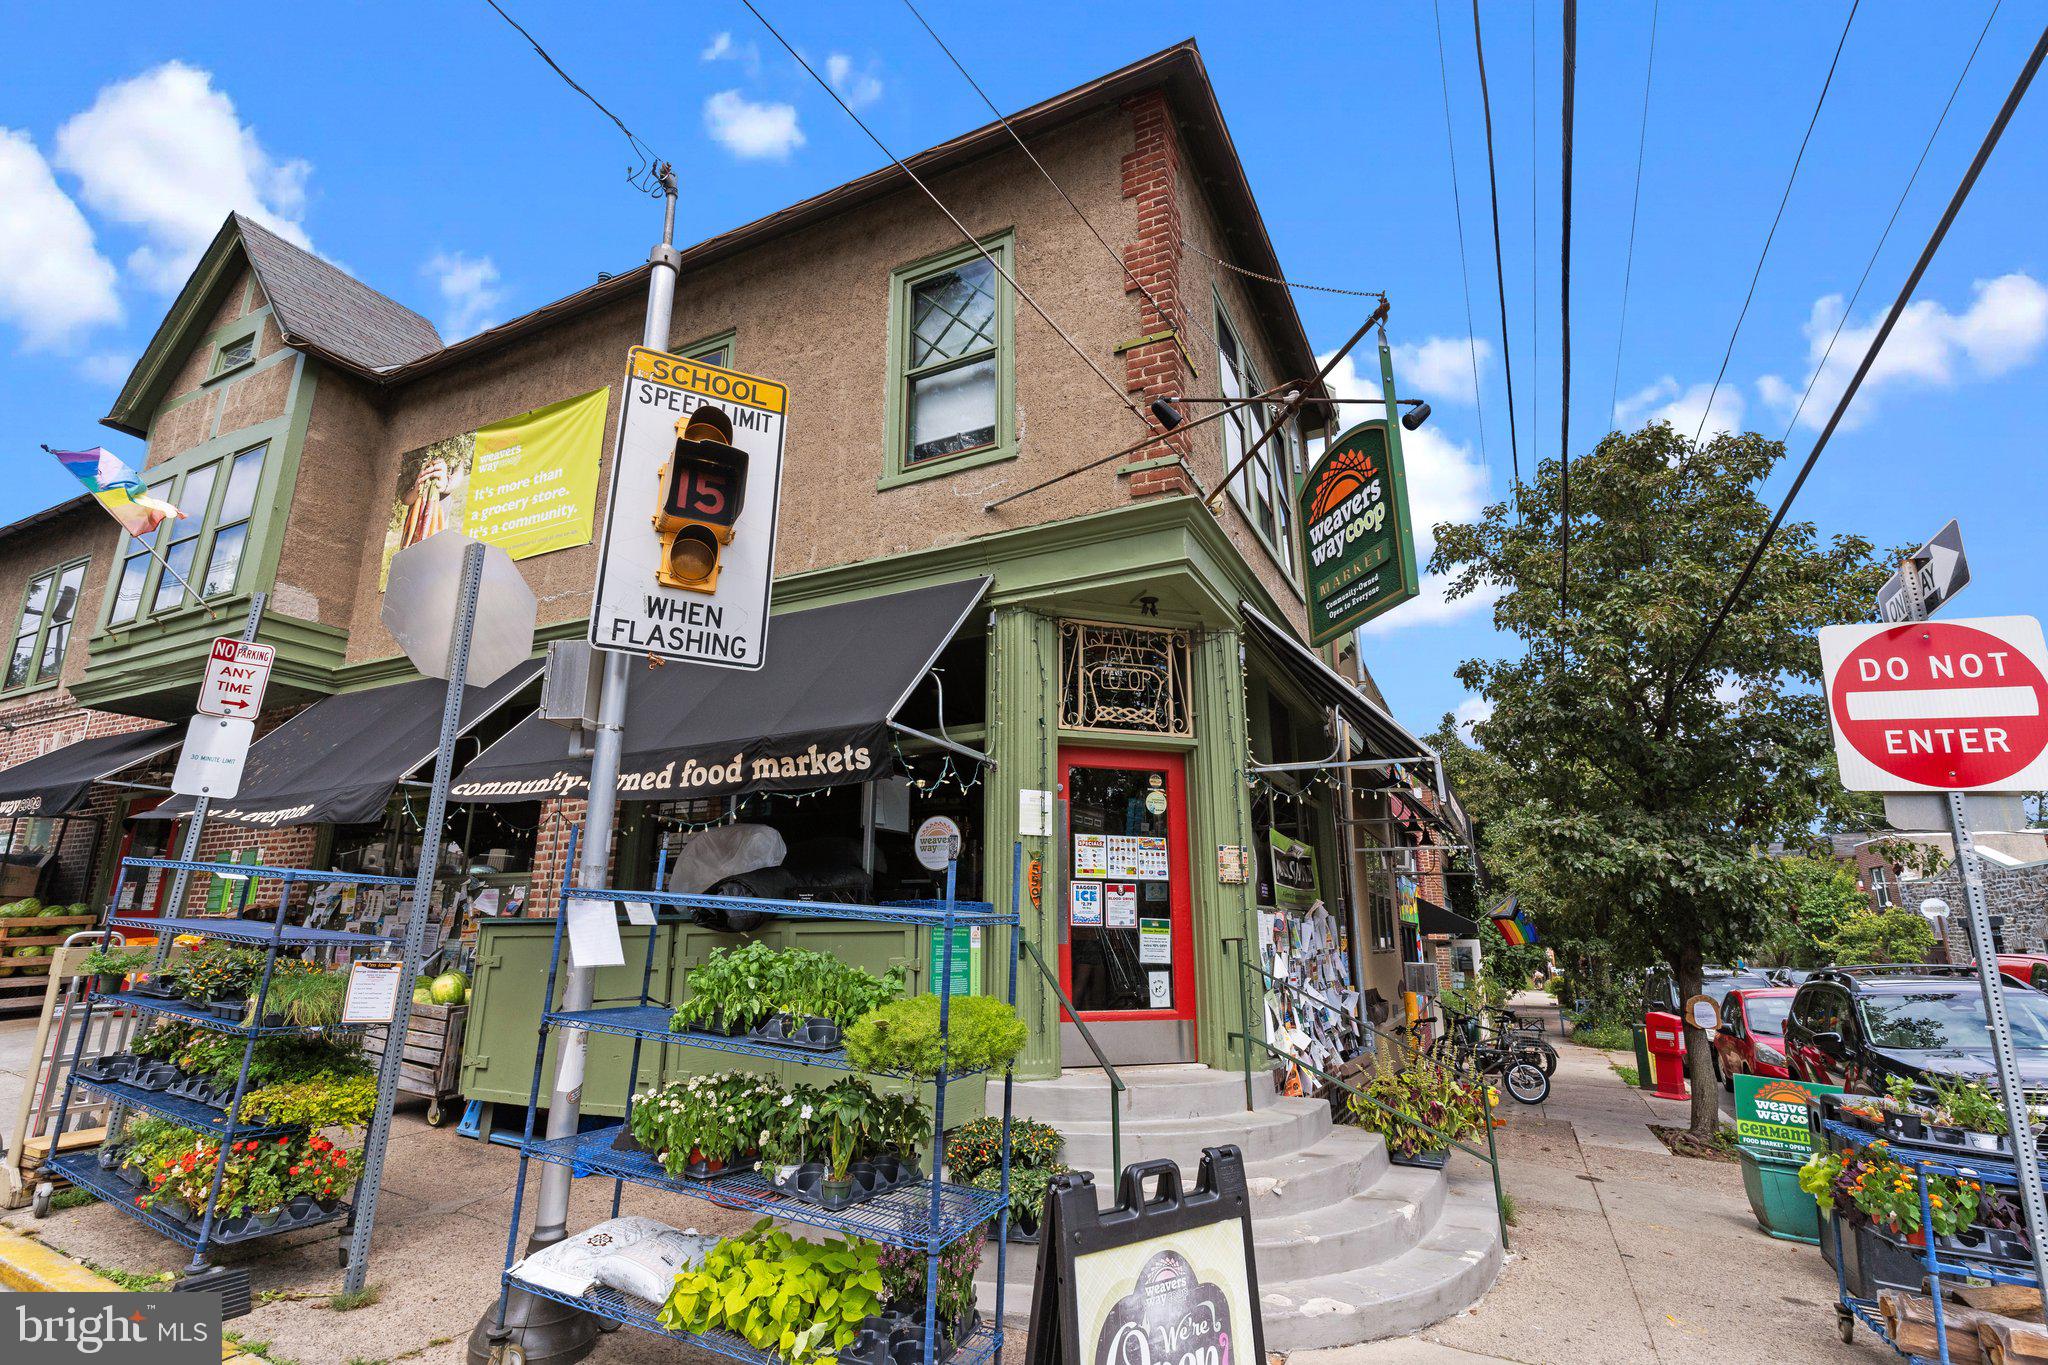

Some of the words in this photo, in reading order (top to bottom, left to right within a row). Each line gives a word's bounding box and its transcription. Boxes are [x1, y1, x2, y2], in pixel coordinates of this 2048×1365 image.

[652, 359, 767, 407] SCHOOL
[480, 444, 522, 463] weavers
[474, 486, 494, 502] It's
[497, 478, 530, 495] more
[533, 467, 563, 485] than
[676, 472, 728, 515] 15
[471, 511, 478, 521] a
[481, 495, 530, 522] grocery
[531, 485, 571, 505] store.
[1309, 478, 1382, 545] weavers
[469, 526, 488, 540] It's
[491, 524, 498, 535] a
[501, 503, 578, 532] community.
[1319, 548, 1384, 597] MARKET
[1921, 563, 1937, 594] AY
[1325, 573, 1379, 610] Community-Owned
[1328, 605, 1344, 619] Open
[1344, 601, 1351, 611] to
[1351, 585, 1380, 606] Everyone
[647, 595, 724, 629] WHEN
[214, 641, 235, 659] NO
[236, 647, 270, 662] PARKING
[610, 618, 748, 660] FLASHING
[1083, 626, 1169, 656] WEAVERS
[219, 666, 257, 680] ANY
[1857, 656, 1909, 682] DO
[1928, 652, 2009, 680] NOT
[217, 680, 253, 695] TIME
[1884, 727, 2012, 755] ENTER
[200, 755, 220, 763] MINUTE
[222, 757, 236, 765] LIMIT
[680, 752, 744, 789] food
[751, 743, 871, 781] markets
[240, 804, 315, 827] everyone
[919, 837, 953, 845] weave
[1075, 890, 1097, 901] ICE
[1754, 1100, 1808, 1115] weave
[1756, 1110, 1809, 1125] wayco
[1760, 1139, 1784, 1148] MARKET
[1145, 1276, 1187, 1297] weavers
[1156, 1313, 1210, 1355] We're
